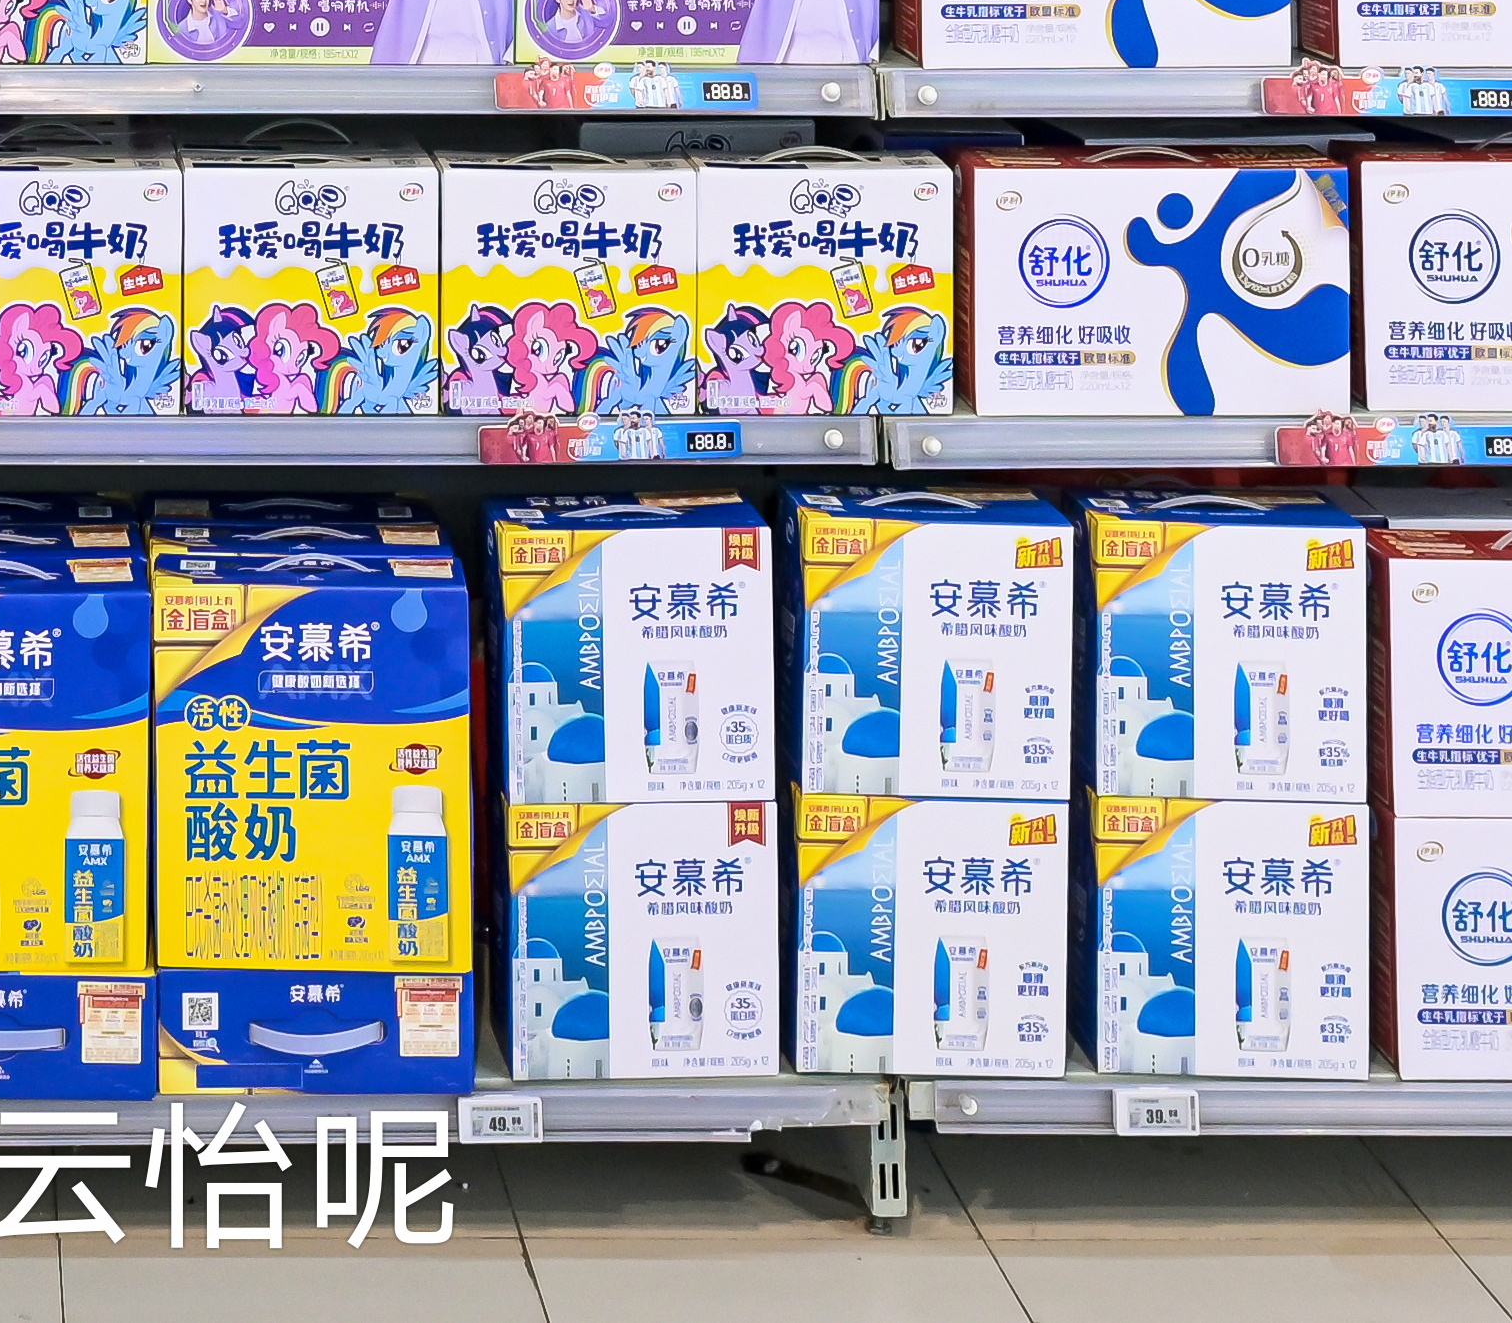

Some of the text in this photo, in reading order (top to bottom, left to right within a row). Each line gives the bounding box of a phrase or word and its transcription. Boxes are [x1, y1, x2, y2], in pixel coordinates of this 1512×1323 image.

[733, 221, 918, 263] 我爱喝牛奶
[1417, 239, 1484, 274] 舒化
[629, 581, 738, 621] 安慕希
[642, 625, 728, 640] 希腊风味酸奶
[1452, 632, 1512, 670] 舒化
[1417, 724, 1493, 744] 营养细化
[185, 740, 350, 801] 益生菌
[185, 803, 296, 862] 酸奶
[634, 857, 744, 896] 安慕希
[1222, 858, 1332, 897] 安慕希
